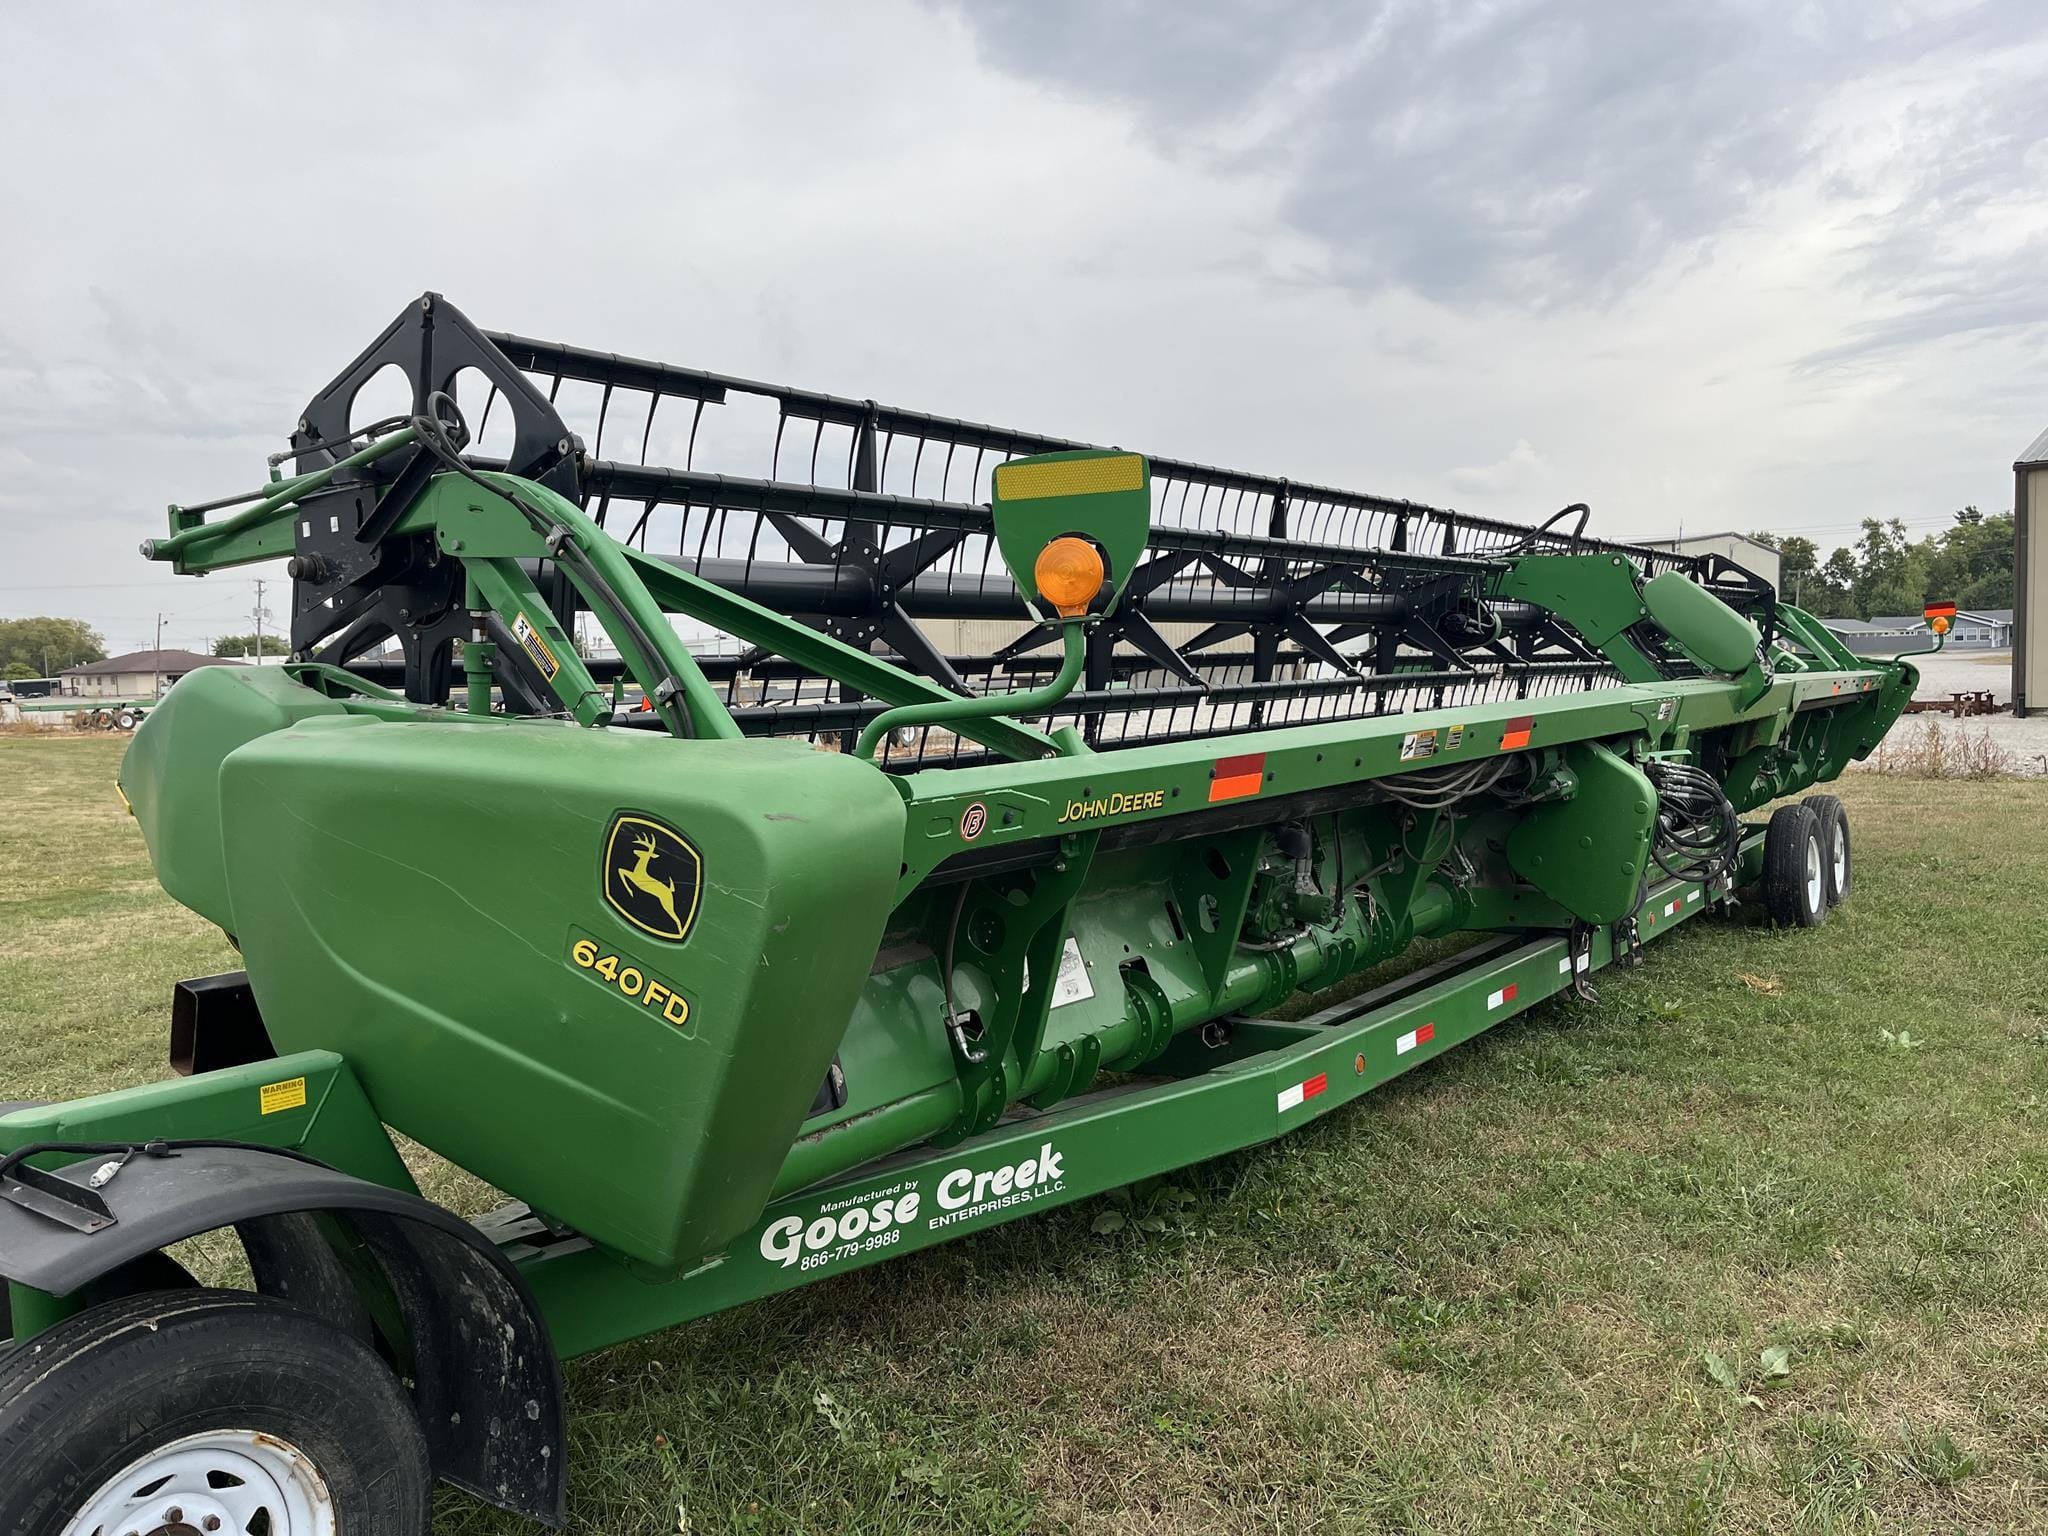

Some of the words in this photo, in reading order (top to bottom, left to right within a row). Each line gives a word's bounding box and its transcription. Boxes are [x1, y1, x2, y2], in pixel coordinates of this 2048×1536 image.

[1058, 799, 1108, 823] JOHN
[1109, 790, 1165, 816] DEERE
[261, 1080, 304, 1095] WARNING
[760, 1192, 921, 1269] Goose
[937, 1142, 1065, 1210] Creek
[820, 1183, 901, 1214] Manufactured
[905, 1180, 919, 1191] by
[929, 1191, 1033, 1230] ENTERPRISES,
[1034, 1181, 1066, 1198] L.L.C.
[800, 1229, 900, 1271] 866-779-9988
